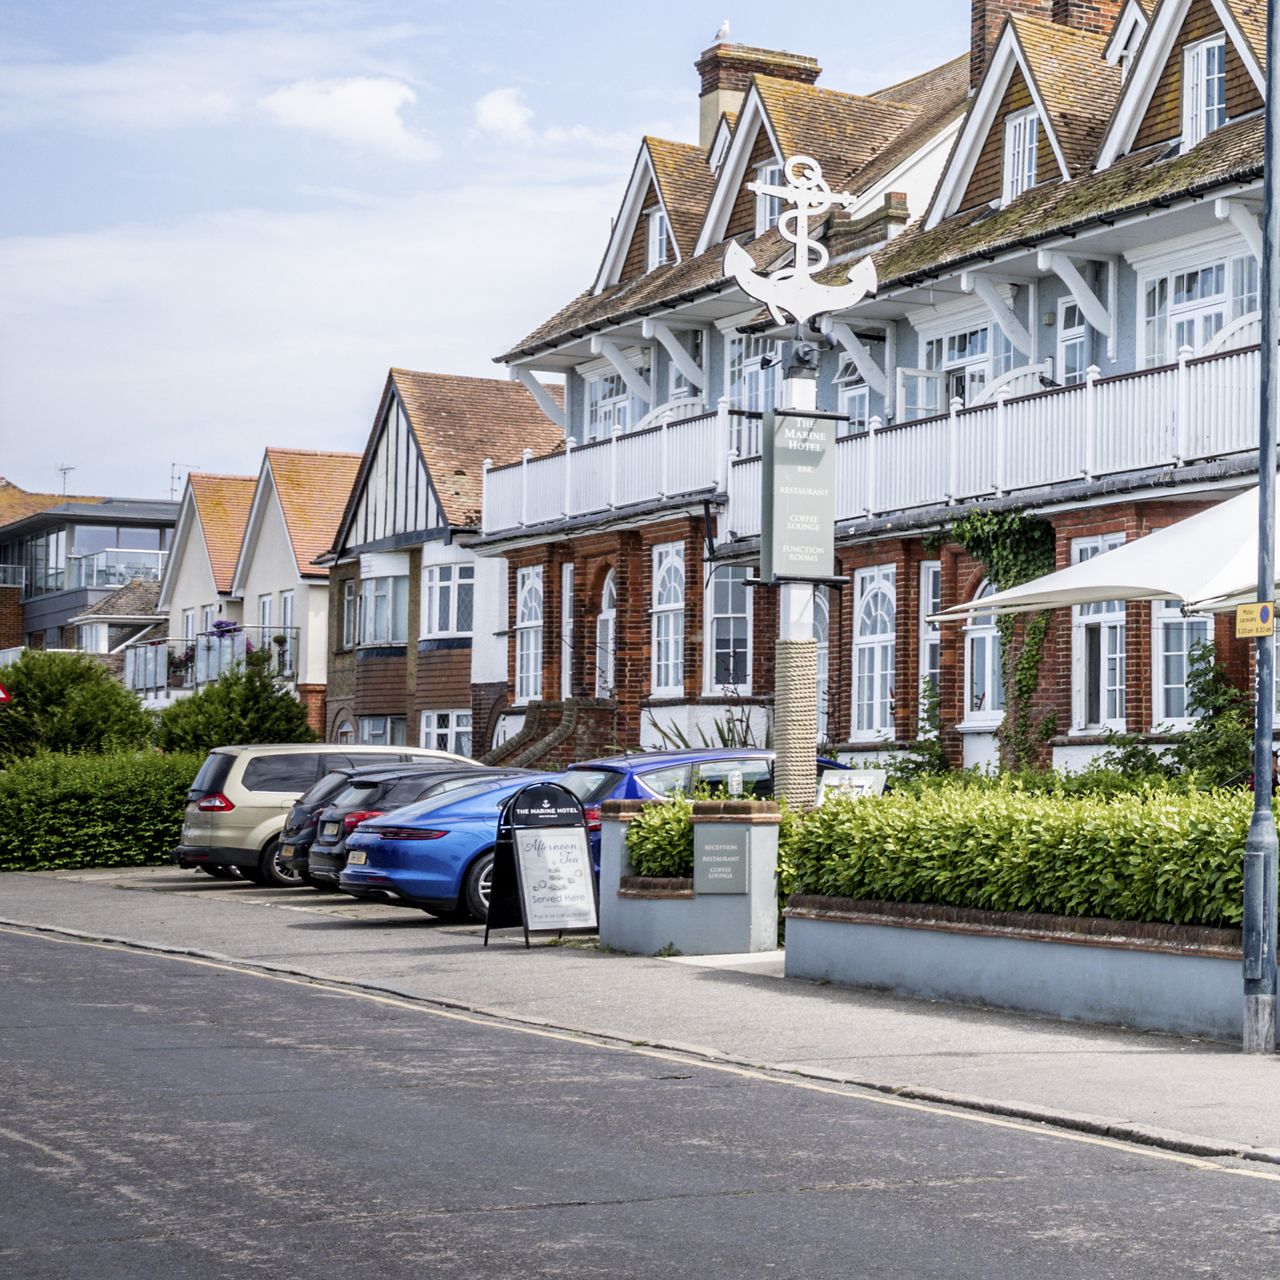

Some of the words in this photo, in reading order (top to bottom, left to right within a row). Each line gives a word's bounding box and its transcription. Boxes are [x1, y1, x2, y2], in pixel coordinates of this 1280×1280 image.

[795, 416, 816, 429] THE
[784, 428, 826, 441] MARINE
[789, 439, 823, 452] HOTEL
[797, 465, 813, 473] BAR
[779, 486, 829, 496] RESTAURANT
[789, 514, 818, 523] COFFEE
[788, 522, 820, 532] LOUNGE
[782, 544, 825, 555] FUNCTION
[788, 552, 818, 562] ROOMS
[524, 839, 577, 858] Afternoon
[560, 850, 579, 865] Tea
[532, 894, 562, 904] Served
[564, 894, 586, 902] Here
